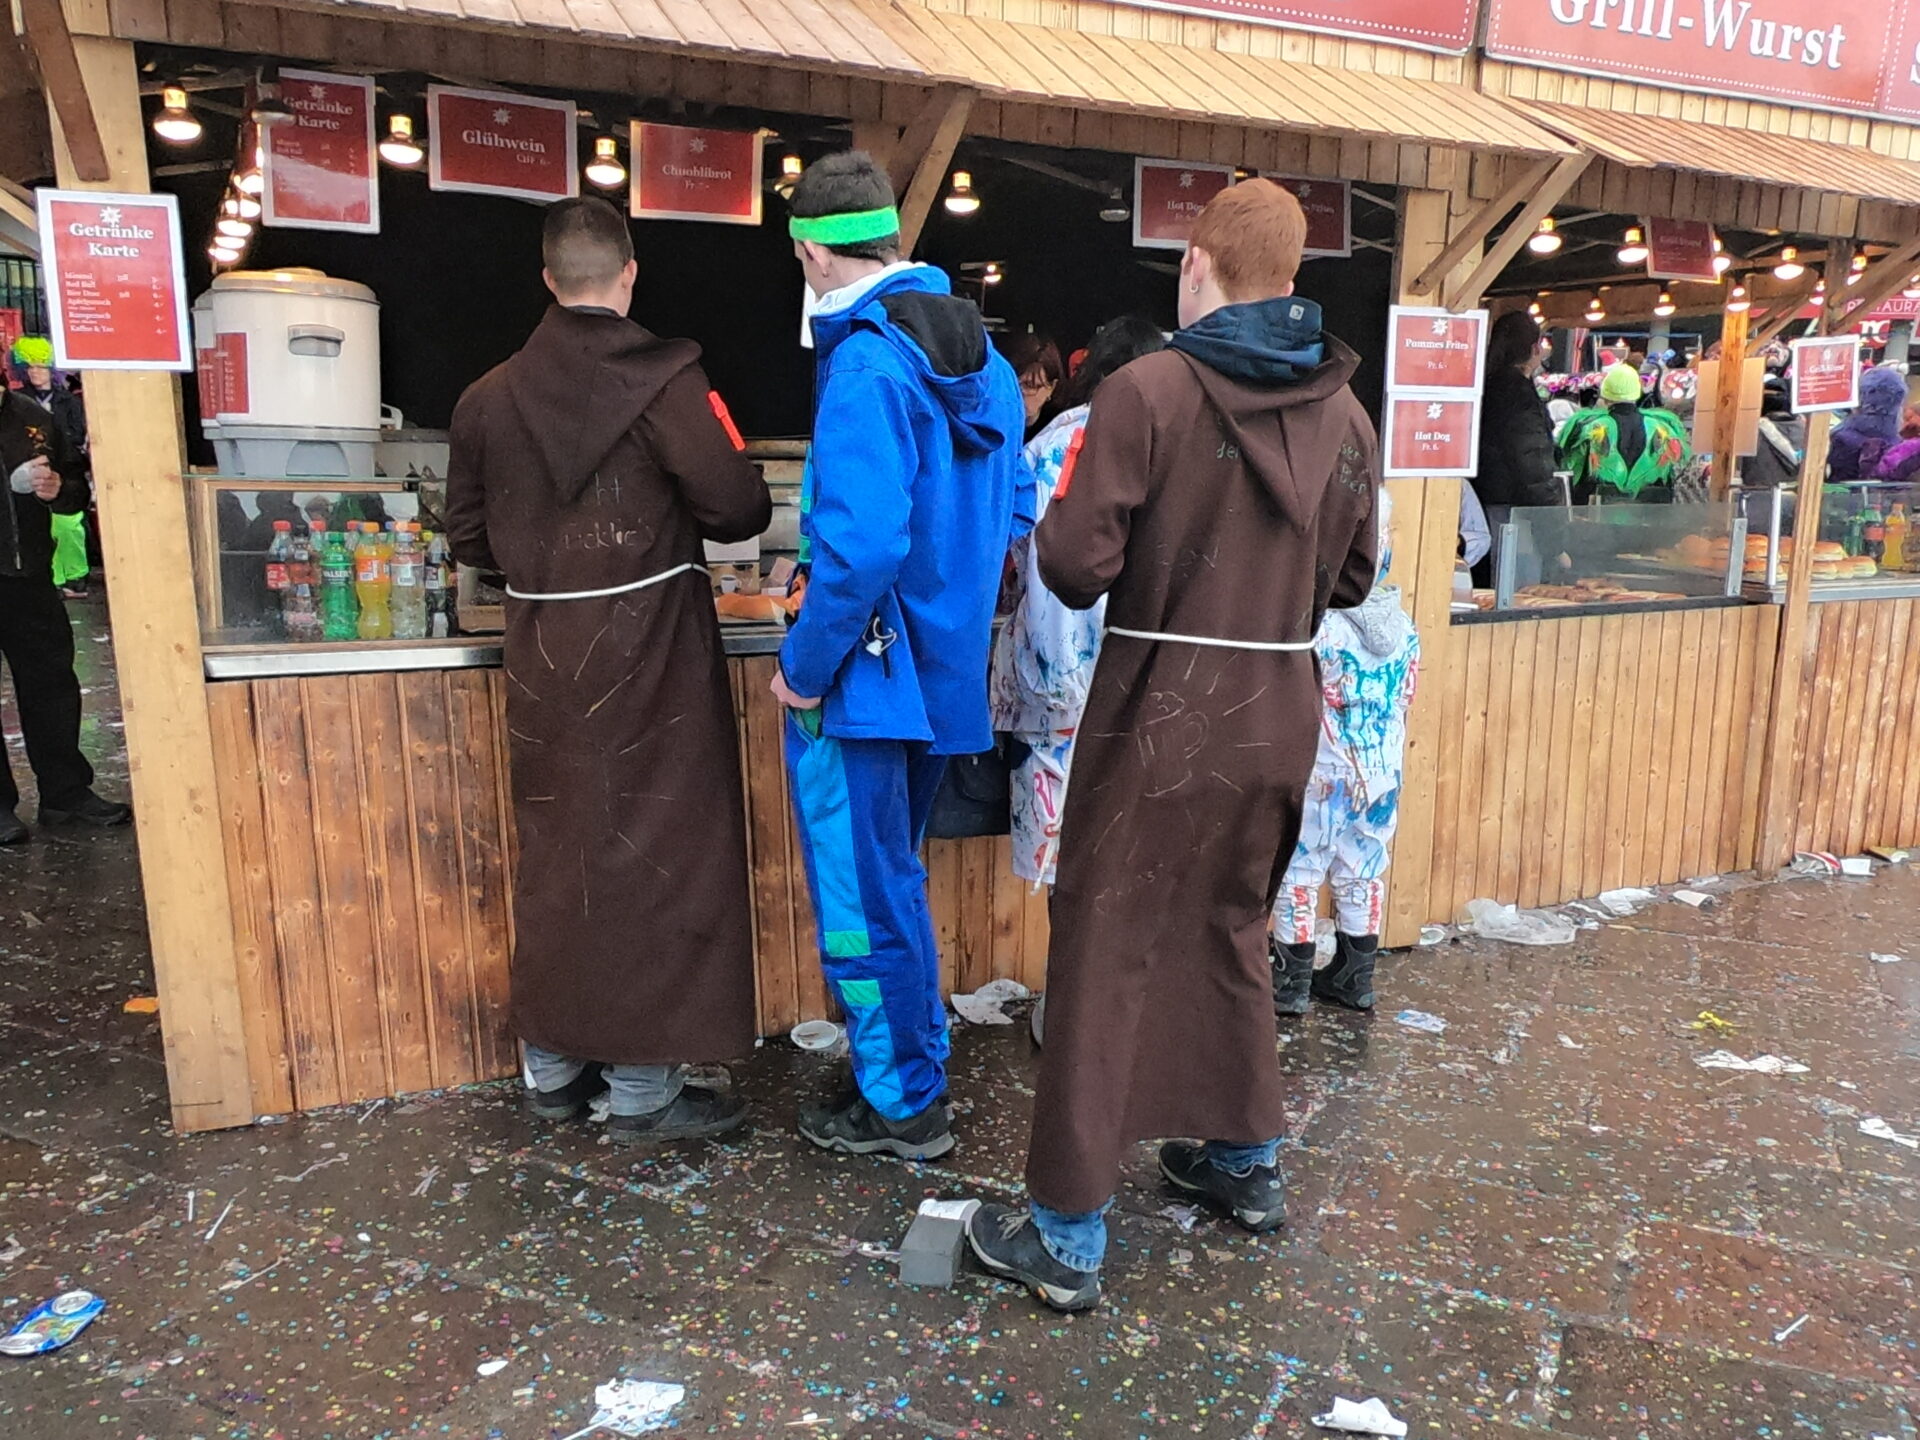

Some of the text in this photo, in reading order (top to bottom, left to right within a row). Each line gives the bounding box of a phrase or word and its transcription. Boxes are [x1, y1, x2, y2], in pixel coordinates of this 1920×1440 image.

[298, 114, 341, 130] Karte
[462, 129, 546, 153] Glühwein
[69, 222, 154, 239] Getränke
[88, 242, 140, 257] Karte
[1405, 338, 1469, 350] Pommes Frites
[1414, 431, 1451, 443] Hot Dog
